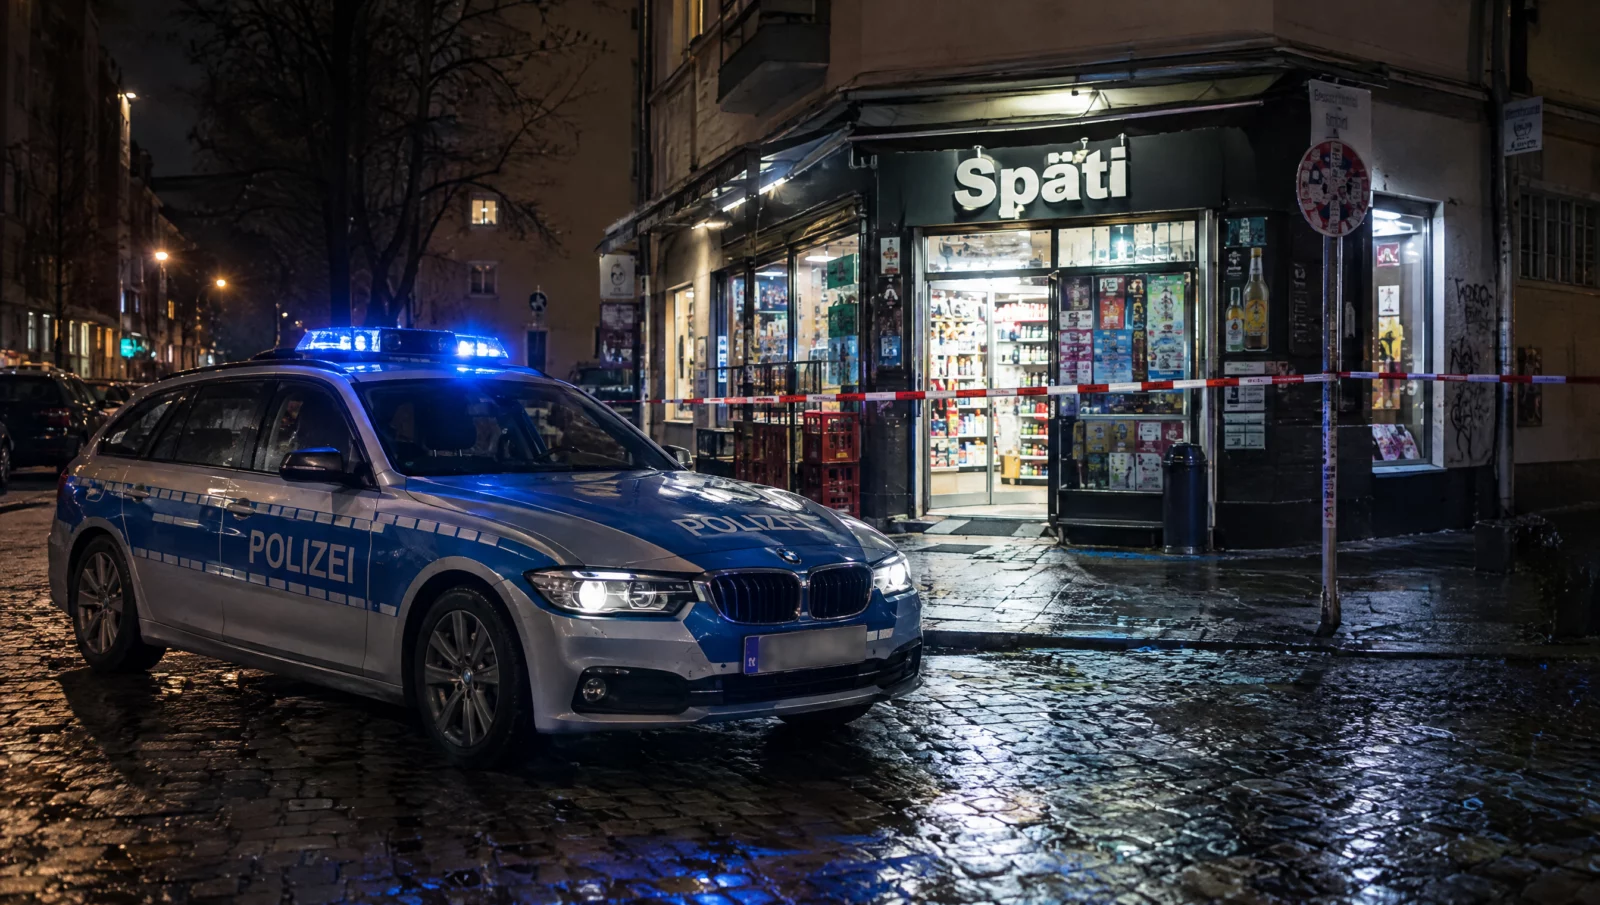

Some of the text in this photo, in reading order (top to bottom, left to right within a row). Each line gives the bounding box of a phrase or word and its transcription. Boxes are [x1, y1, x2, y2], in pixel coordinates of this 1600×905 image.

[954, 146, 1127, 219] Späti
[671, 514, 818, 537] POLIZEI
[248, 529, 355, 584] POLIZEI
